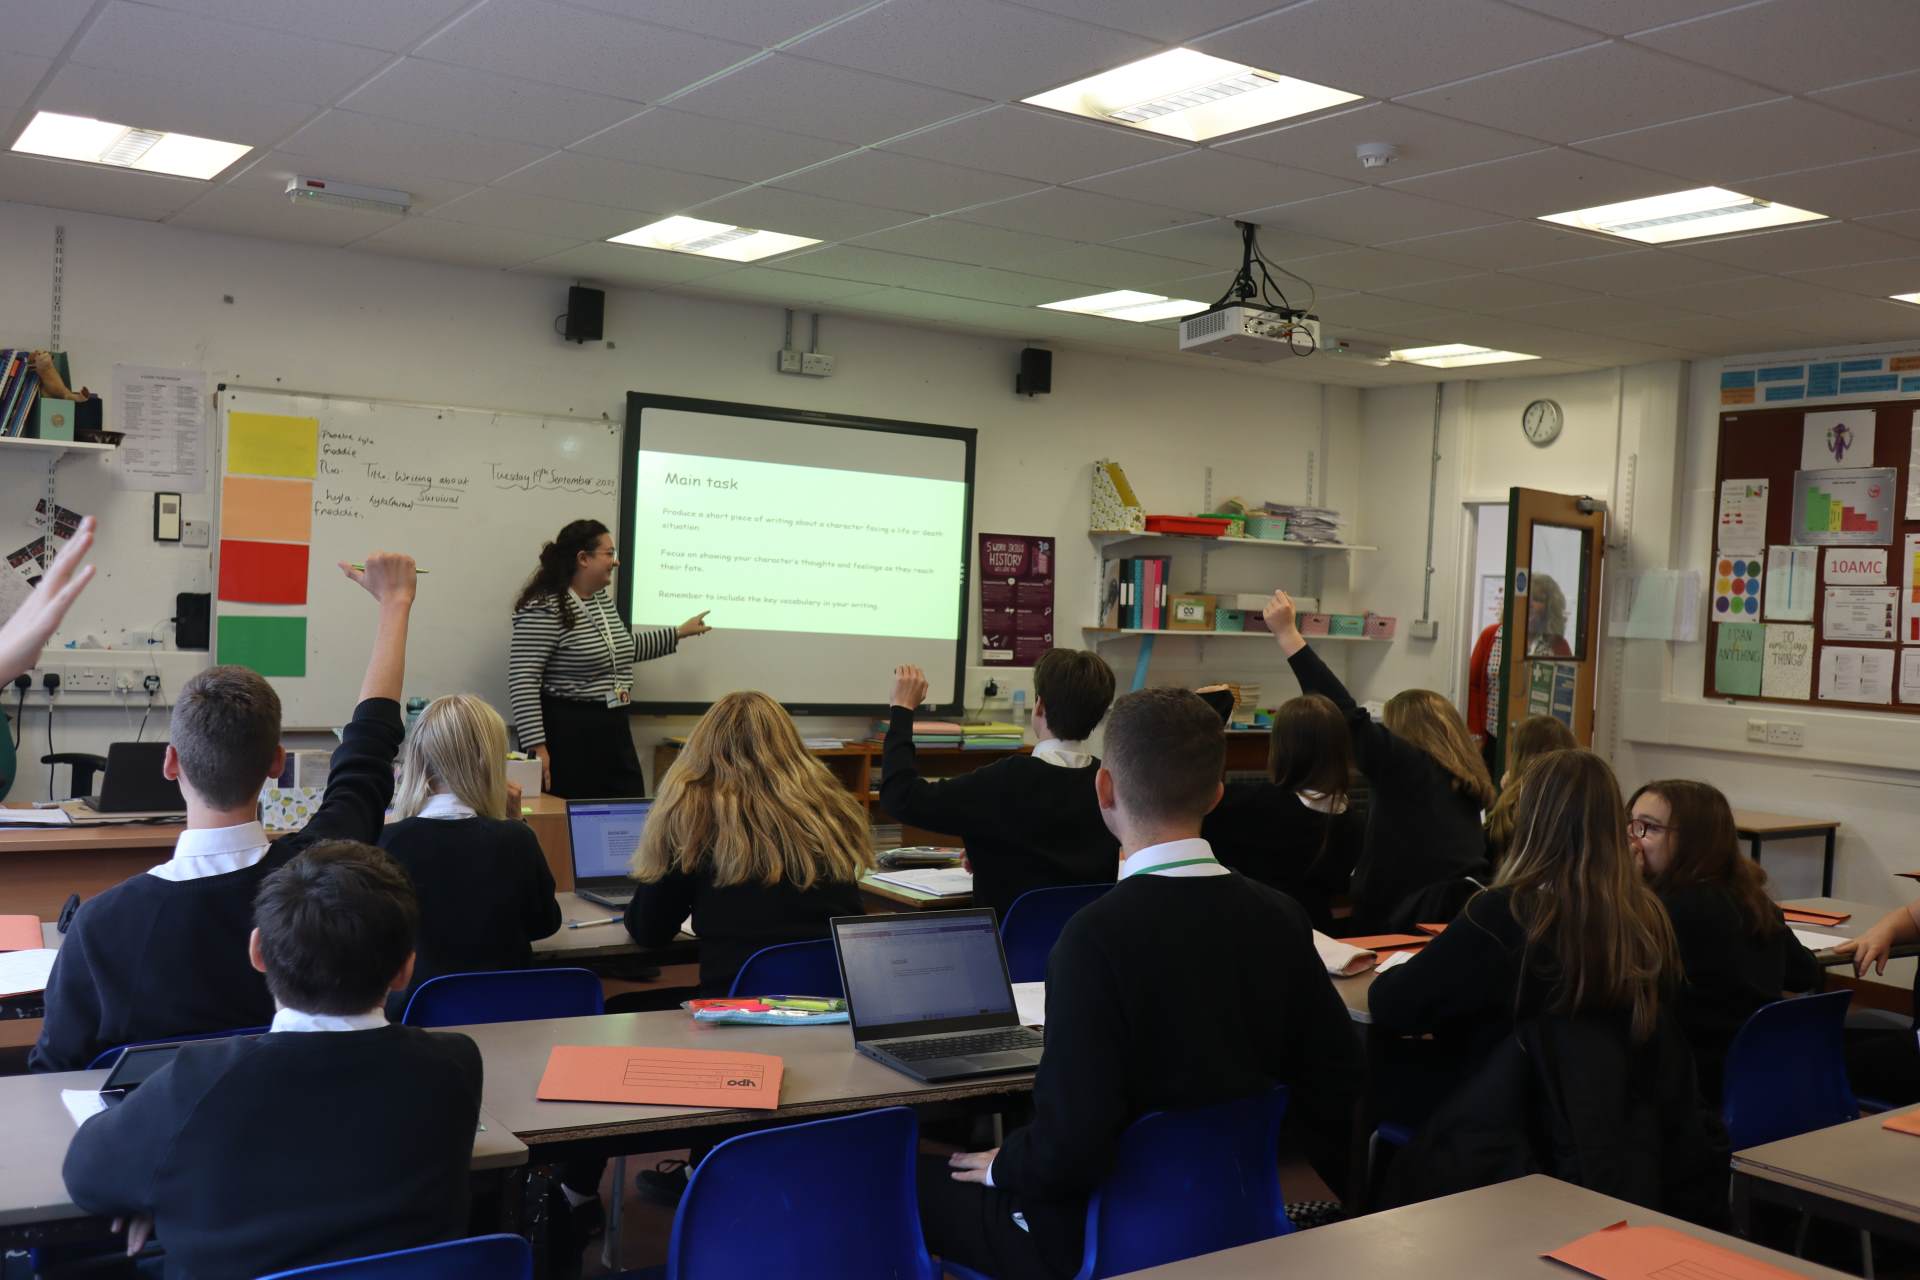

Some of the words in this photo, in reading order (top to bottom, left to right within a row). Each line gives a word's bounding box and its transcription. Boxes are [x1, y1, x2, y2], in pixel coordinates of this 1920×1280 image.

[395, 471, 432, 488] Writing
[440, 476, 469, 486] about
[482, 462, 530, 491] Tuesday
[548, 468, 592, 486] September
[664, 472, 701, 487] Main
[706, 477, 739, 490] task
[417, 488, 459, 504] Survival
[662, 507, 697, 518] Produce
[706, 511, 729, 520] short
[730, 513, 752, 523] piece
[754, 514, 764, 522] of
[765, 516, 794, 528] writing
[795, 518, 818, 528] about
[826, 521, 864, 530] character
[866, 523, 889, 535] facing
[897, 526, 910, 535] life
[922, 529, 944, 537] death
[986, 541, 992, 553] 5
[660, 548, 685, 557] Focus
[699, 551, 732, 562] showing
[734, 555, 753, 563] your
[754, 555, 799, 566] character's
[801, 558, 835, 569] thoughts
[837, 561, 851, 569] and
[853, 561, 883, 573] feelings
[895, 565, 911, 574] they
[913, 567, 934, 575] reach
[660, 562, 682, 571] their
[684, 563, 704, 573] fate.
[989, 552, 1023, 567] HISTORY
[1831, 560, 1882, 574] 10AMC
[658, 590, 703, 600] Remember
[716, 593, 746, 602] include
[748, 595, 761, 603] the
[763, 595, 778, 606] key
[780, 597, 821, 608] vocabulary
[832, 601, 849, 609] your
[1719, 648, 1761, 662] ANYTHING
[1772, 652, 1803, 666] THINGS
